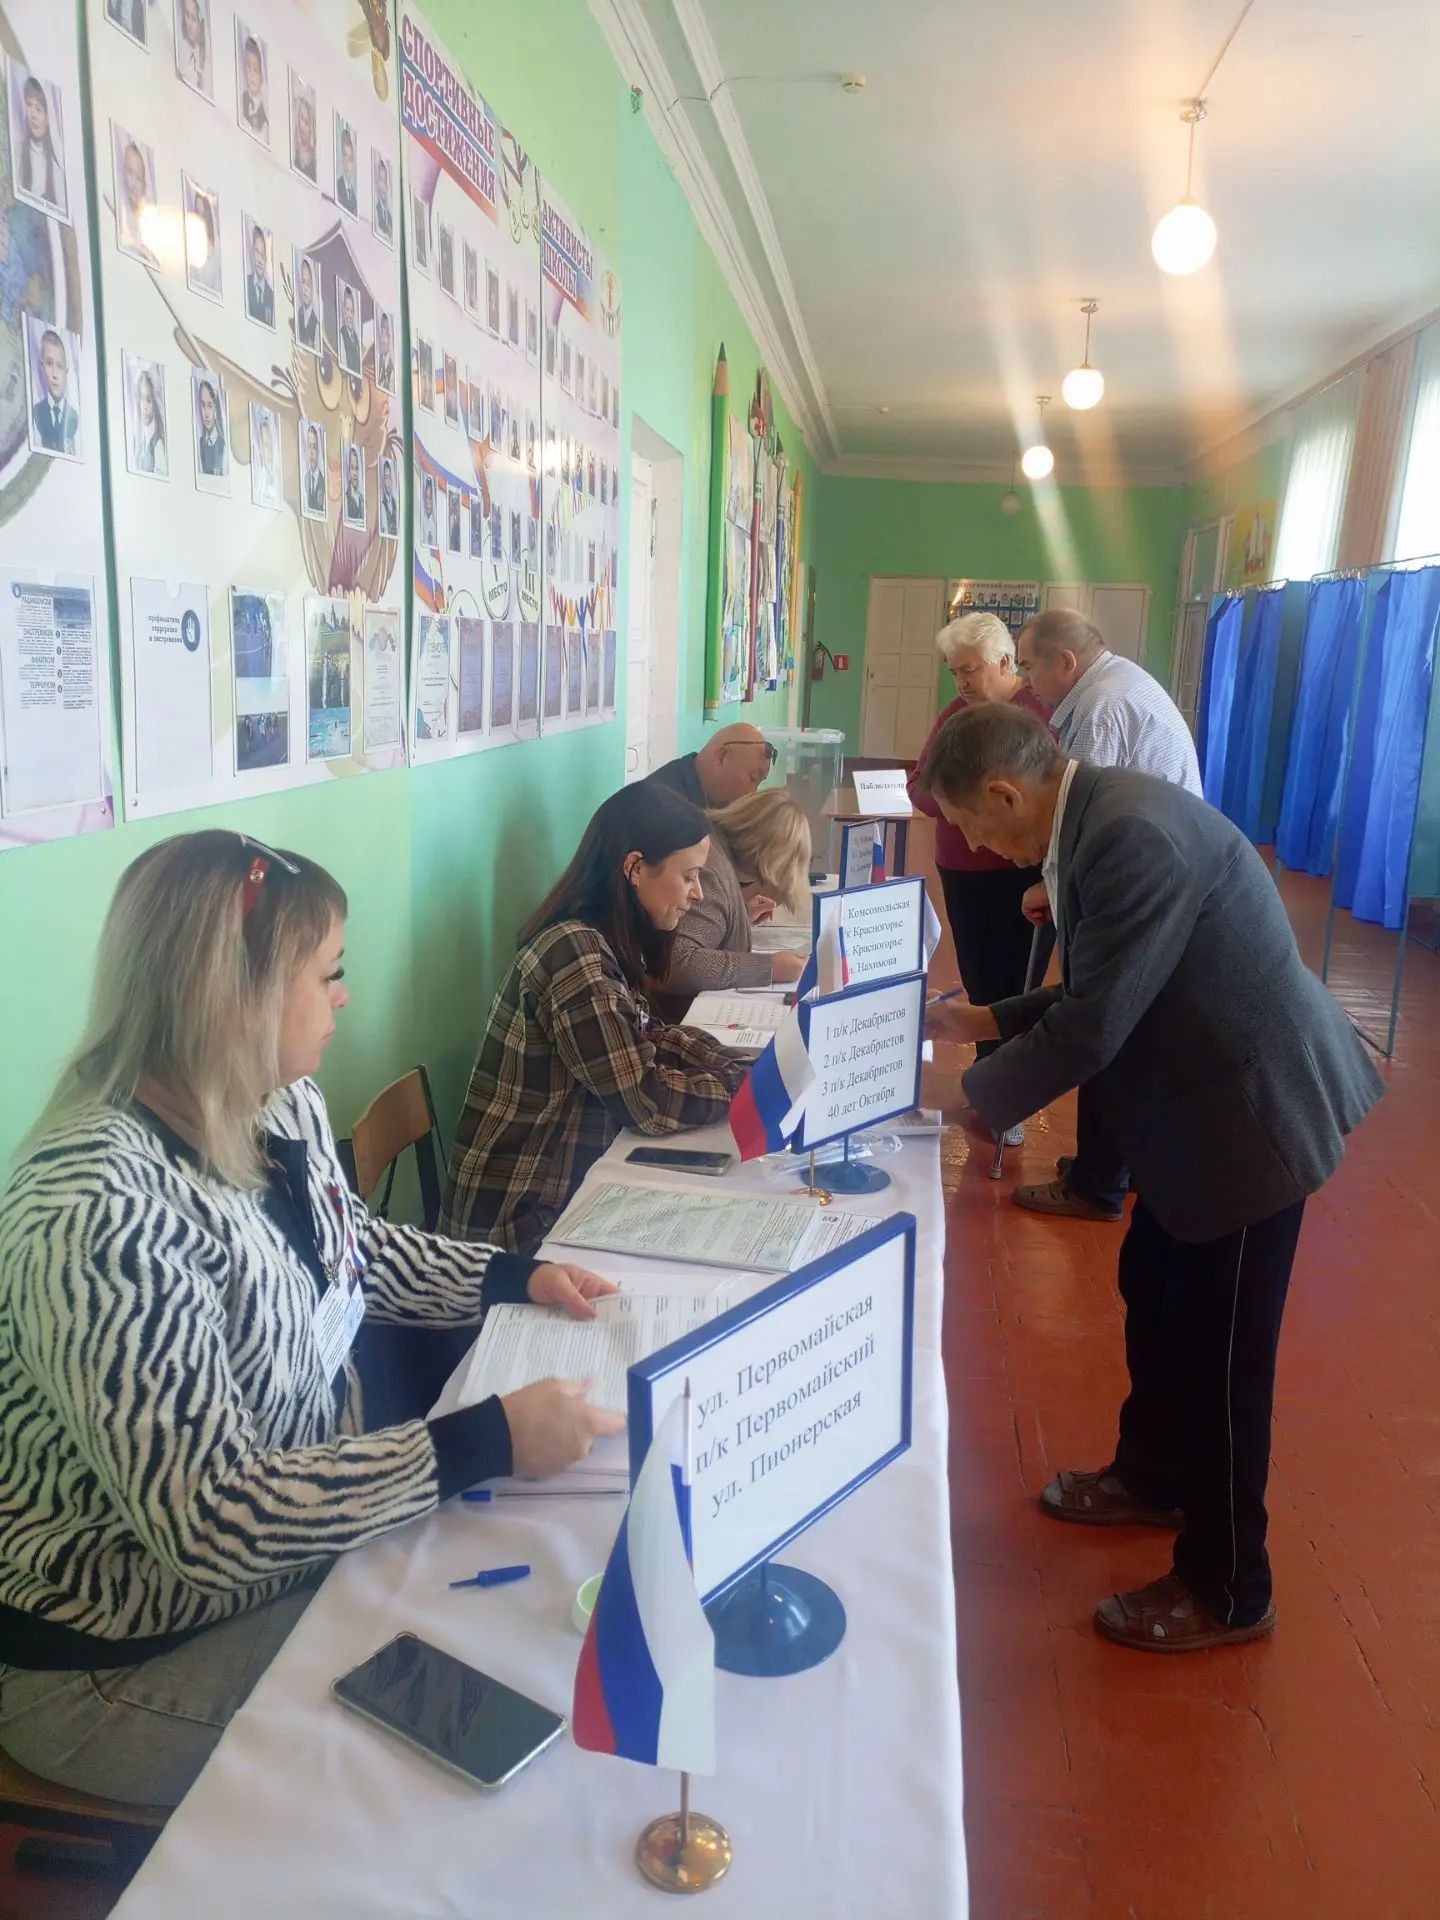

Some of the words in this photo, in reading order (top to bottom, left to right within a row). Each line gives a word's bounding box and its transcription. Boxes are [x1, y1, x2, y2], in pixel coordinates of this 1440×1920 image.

[402, 14, 495, 160] СПОРТИВНЫЕ
[403, 65, 496, 205] ДОСТИЖЕНИЯ
[542, 199, 592, 280] АКТИВИСТЫ
[543, 238, 576, 299] ШКОЛЫ
[489, 581, 507, 602] МЕСТО
[521, 590, 538, 611] МЕСТО
[848, 900, 910, 920] Комсомольская
[853, 920, 903, 938] Красногорье
[852, 937, 903, 957] Красногорье
[857, 957, 897, 973] Нахимова
[826, 1026, 830, 1041] 1
[833, 1020, 848, 1040] п/к
[849, 1007, 906, 1036] Декабристов
[823, 1054, 829, 1069] 2
[831, 1048, 847, 1066] п/к
[848, 1034, 905, 1062] Декабристов
[822, 1081, 828, 1096] 3
[830, 1075, 845, 1093] п/к
[847, 1059, 904, 1088] Декабристов
[827, 1105, 840, 1120] 40
[841, 1100, 856, 1116] лет
[859, 1086, 896, 1109] Октября
[697, 1391, 728, 1429] ул.
[736, 1295, 873, 1396] Первомайская
[696, 1433, 729, 1475] п/к
[735, 1333, 875, 1447] Первомайский
[711, 1480, 743, 1518] ул.
[749, 1390, 862, 1483] Пионерская
